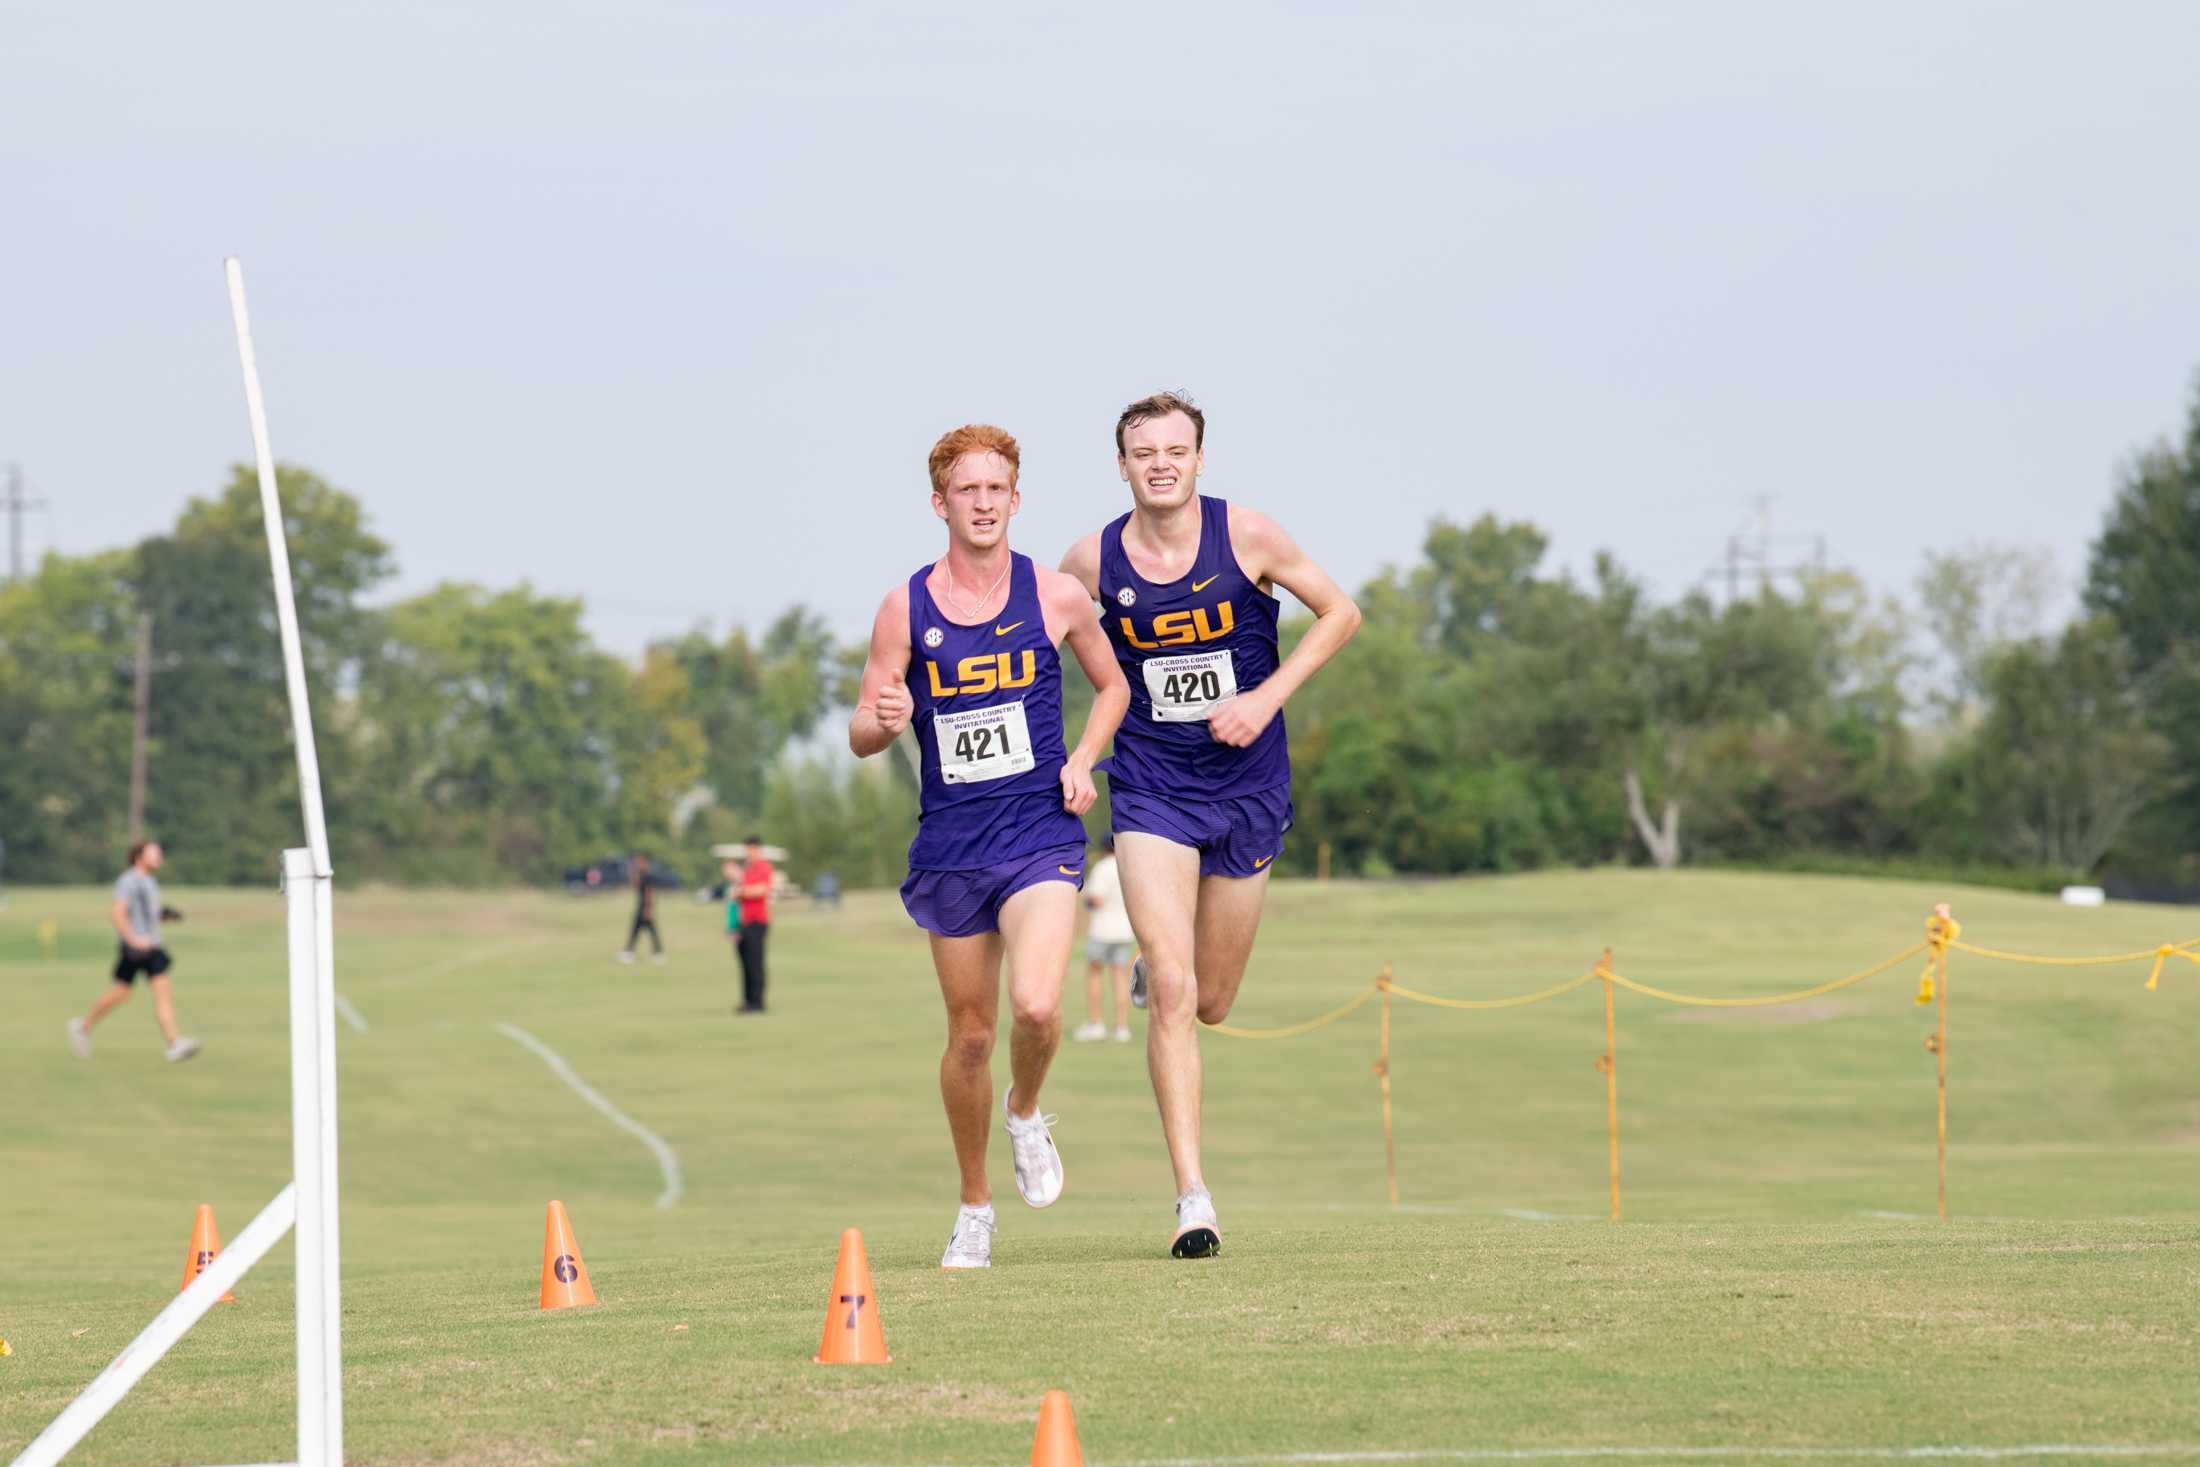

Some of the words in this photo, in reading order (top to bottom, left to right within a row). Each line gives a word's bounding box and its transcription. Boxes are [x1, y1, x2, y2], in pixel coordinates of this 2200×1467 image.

[1120, 601, 1234, 649] LSU
[926, 650, 1036, 697] LSU
[1163, 663, 1212, 673] INVITATIONAL
[1190, 654, 1223, 664] COUNTRY
[1163, 670, 1221, 704] 420
[954, 716, 1005, 730] INVITATIONAL
[982, 705, 1016, 719] COUNTRY
[955, 724, 1011, 762] 421
[554, 1254, 578, 1283] 6
[840, 1295, 865, 1329] 7
